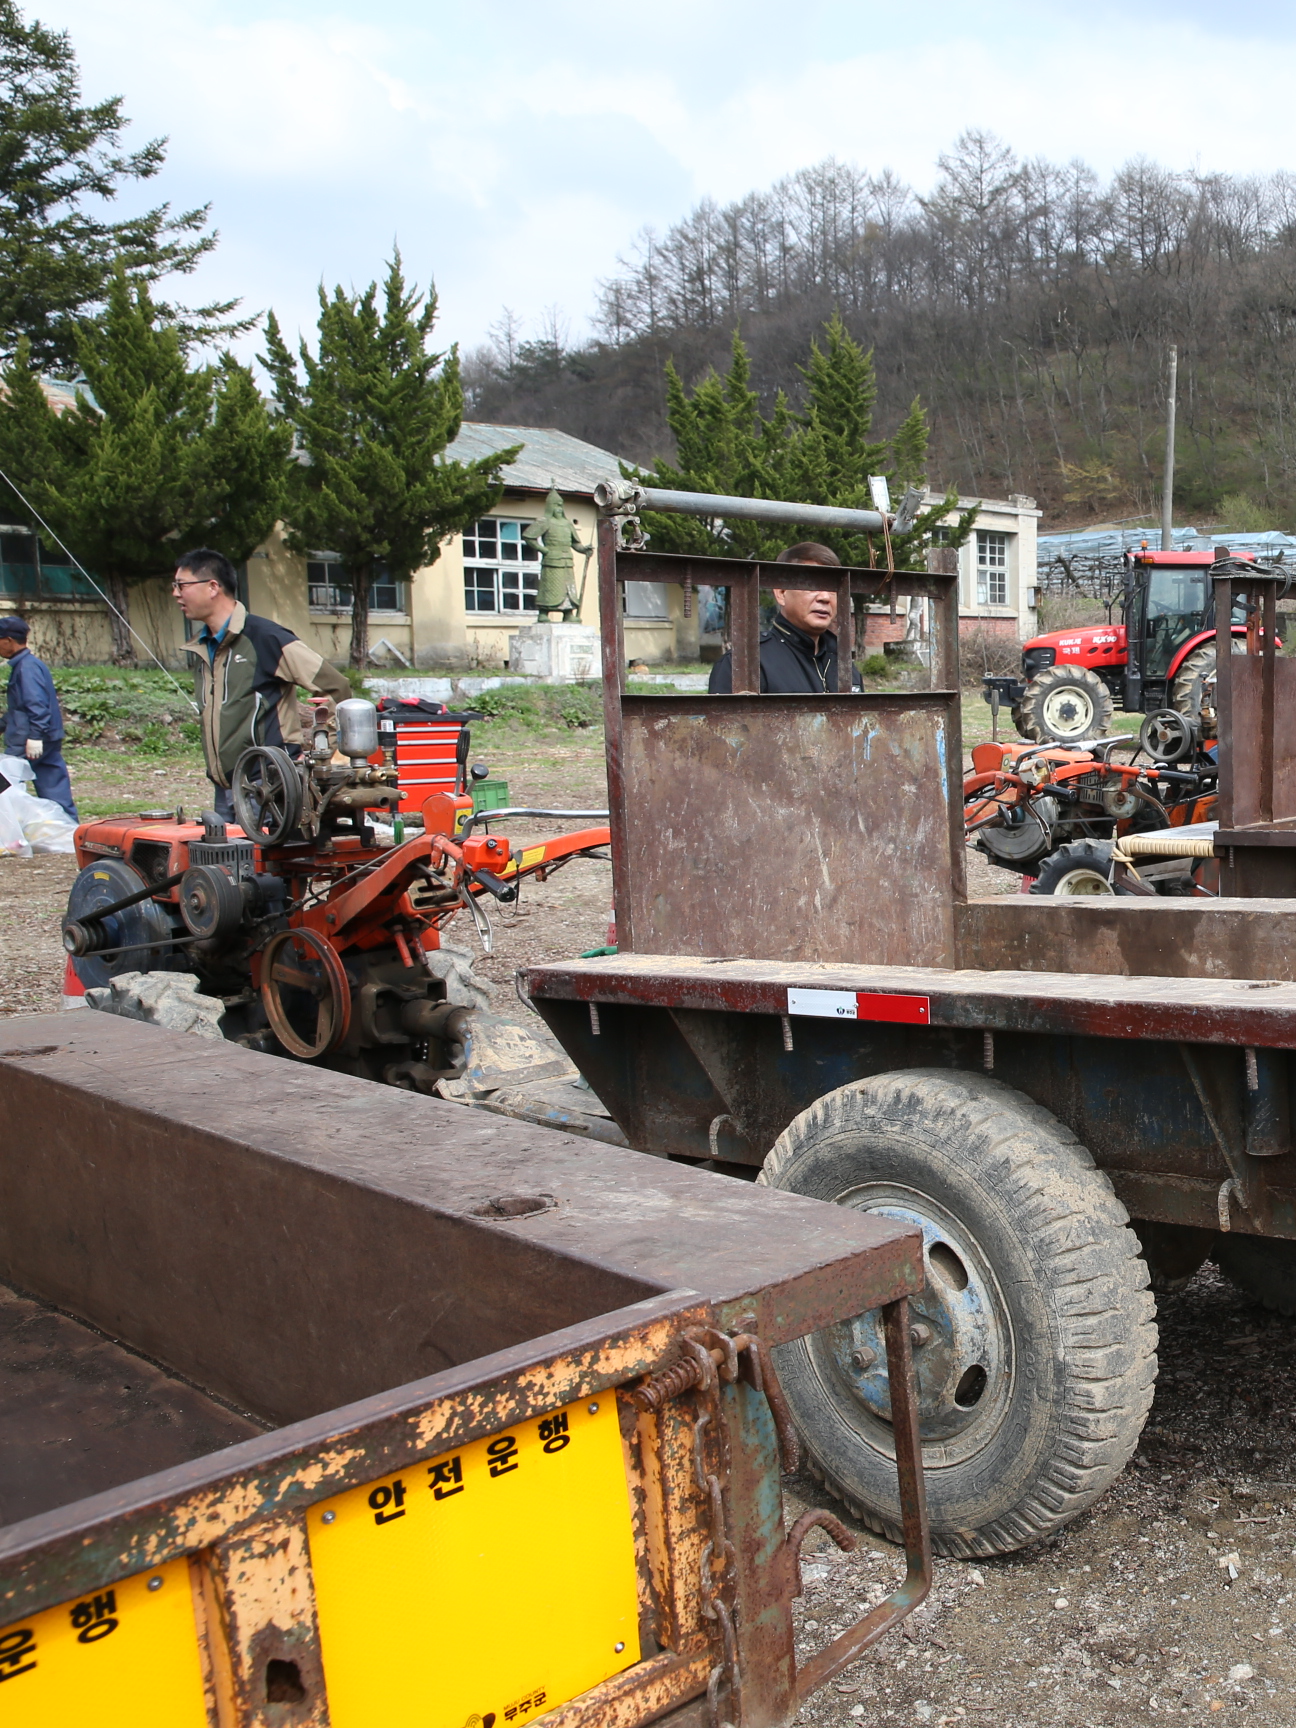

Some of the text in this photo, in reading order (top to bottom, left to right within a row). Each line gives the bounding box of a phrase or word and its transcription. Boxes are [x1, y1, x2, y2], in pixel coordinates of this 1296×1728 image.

[1059, 638, 1082, 646] KUKJE
[521, 1684, 546, 1701] COUNTY
[504, 1691, 547, 1721] 무주군
